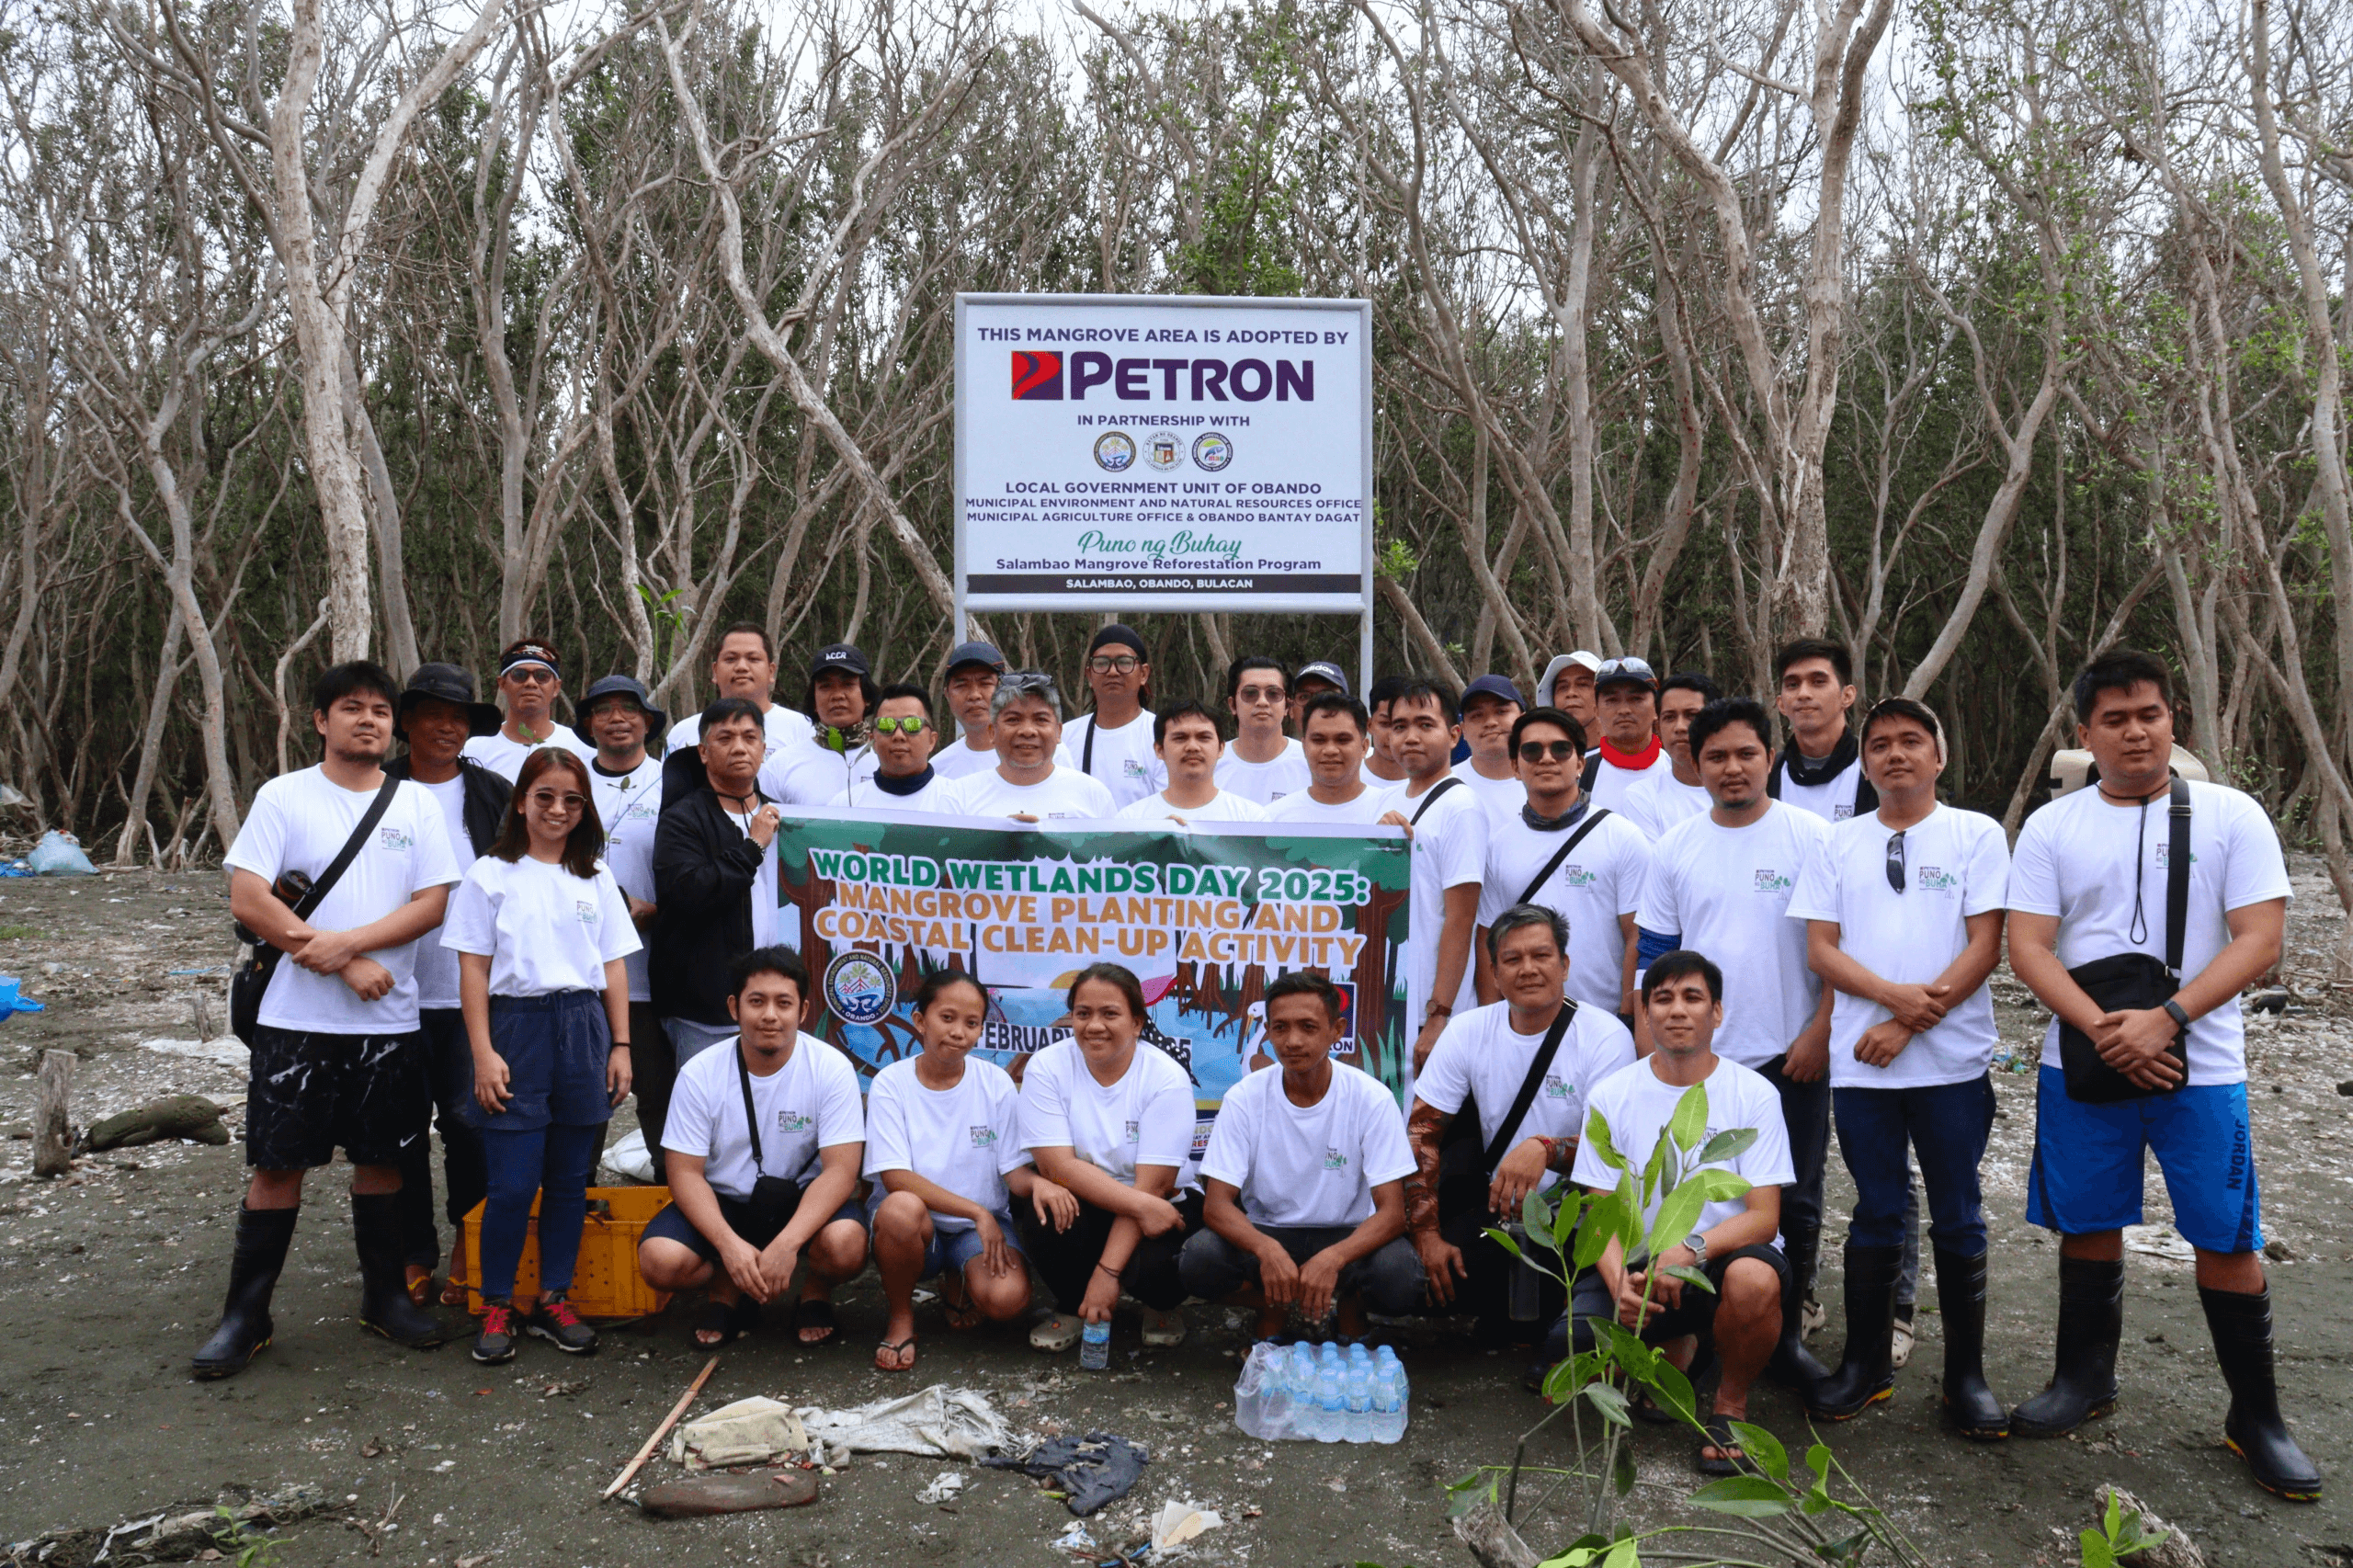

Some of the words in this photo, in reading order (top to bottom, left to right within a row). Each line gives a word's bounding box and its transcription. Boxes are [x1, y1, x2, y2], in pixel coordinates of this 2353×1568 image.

[977, 327, 1021, 342] THIS
[1027, 327, 1140, 342] MANGROVE
[1144, 328, 1198, 343] AREA
[1203, 329, 1222, 343] IS
[1225, 329, 1319, 345] ADOPTED
[1324, 331, 1349, 345] BY
[1070, 350, 1314, 403] PETRON
[1077, 415, 1093, 426] IN
[1097, 415, 1205, 426] PARTNERSHIP
[1209, 415, 1250, 426] WITH
[1006, 482, 1061, 494] LOCAL
[1064, 482, 1178, 494] GOVERNMENT
[1182, 483, 1221, 494] UNIT
[1224, 483, 1247, 494] OF
[1251, 483, 1322, 494] OBANDO
[965, 498, 1037, 508] MUNICIPAL
[1040, 498, 1136, 508] ENVIRONMENT
[1139, 498, 1167, 508] AND
[1170, 498, 1233, 508] NATURAL
[1235, 498, 1313, 508] RESOURCES
[1315, 499, 1362, 509] OFFICE
[967, 512, 1039, 522] MUNICIPAL
[1041, 512, 1133, 522] AGRICULTURE
[1136, 512, 1183, 522] OFFICE
[1186, 512, 1195, 522] &
[1198, 512, 1255, 522] OBANDO
[1258, 513, 1312, 522] BANTAY
[1315, 513, 1360, 523] DAGAT
[1077, 529, 1137, 554] Puno
[1141, 539, 1166, 562] ng
[1168, 529, 1243, 562] Buhay
[996, 558, 1071, 570] Salambao
[1075, 559, 1149, 571] Mangrove
[1154, 559, 1253, 569] Reforestation
[1257, 558, 1322, 572] Program
[1065, 578, 1137, 590] SALAMBAO,
[1138, 578, 1194, 590] OBANDO,
[1196, 578, 1254, 589] BULACAN
[1834, 809, 1852, 817] PUNO
[381, 831, 401, 840] PUNO
[813, 850, 938, 888] WORLD
[949, 861, 1156, 894] WETLANDS
[1169, 866, 1246, 897] DAY
[1260, 870, 1369, 903] 2025:
[1565, 869, 1582, 877] PUNO
[1755, 873, 1775, 881] PUNO
[1919, 870, 1940, 880] PUNO
[576, 903, 594, 914] PUNO
[838, 882, 1038, 923] MANGROVE
[1051, 896, 1240, 929] PLANTING
[1253, 903, 1339, 933] AND
[816, 910, 970, 950] COASTAL
[982, 925, 1168, 957] CLEAN-UP
[1180, 932, 1363, 966] ACTIVITY
[860, 954, 881, 968] NATURAL
[828, 956, 848, 985] ENVIRONMENT
[880, 966, 892, 998] RESOURCES
[829, 984, 843, 1011] MUNICIPAL
[845, 1011, 876, 1021] OBANDO
[778, 1115, 797, 1123] PUNO
[971, 1130, 990, 1139] PUNO
[2226, 1119, 2246, 1190] JORDAN
